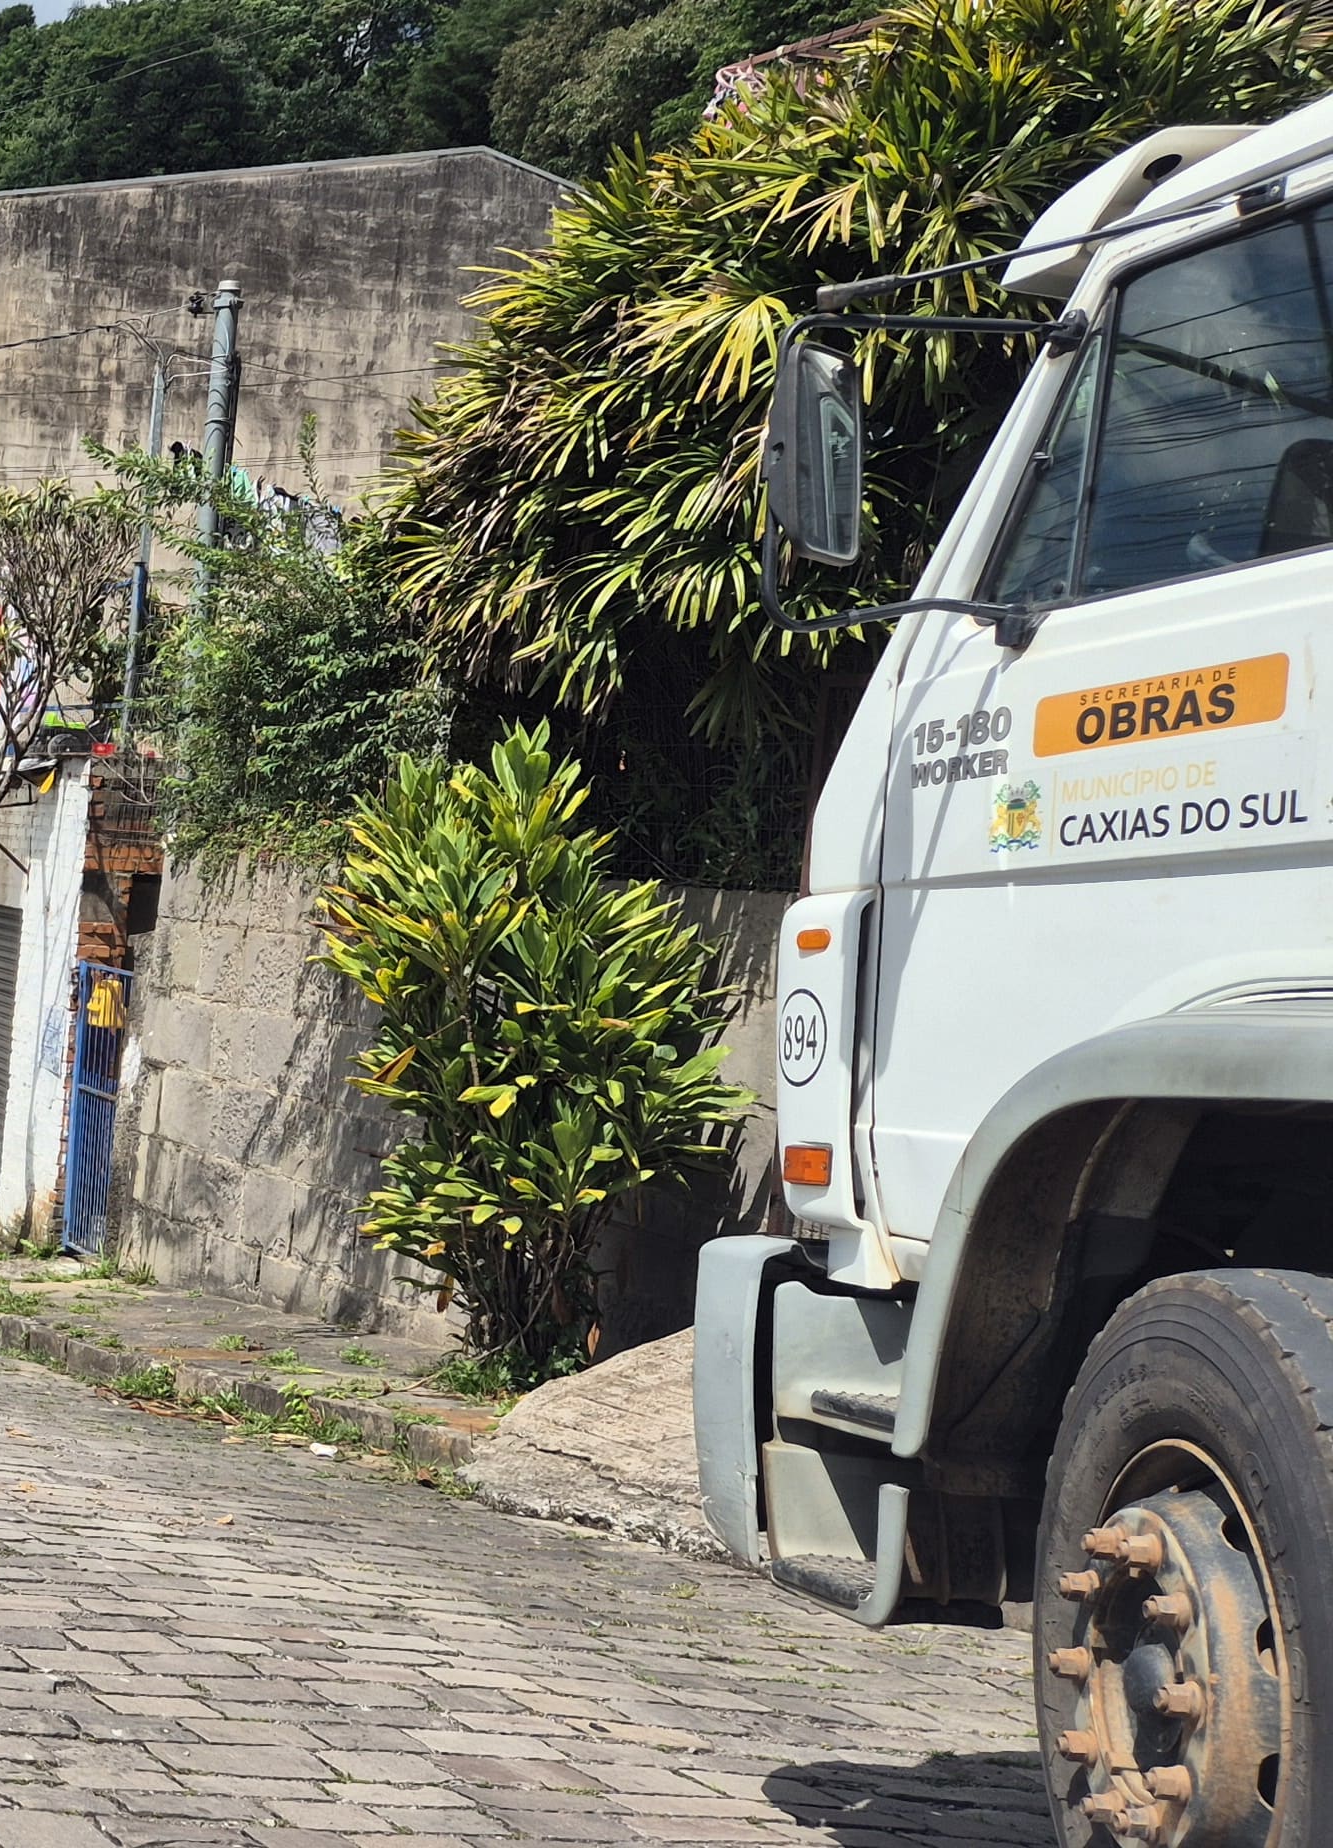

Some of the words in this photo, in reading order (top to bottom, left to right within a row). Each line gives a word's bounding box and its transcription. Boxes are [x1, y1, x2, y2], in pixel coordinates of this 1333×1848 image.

[1080, 673, 1204, 706] SECRETARIA
[1212, 667, 1237, 683] DE
[914, 706, 1012, 755] 15-180
[1076, 683, 1236, 745] OBRAS
[911, 749, 1009, 789] WORKER
[1061, 764, 1179, 804] MUNICÍPIO
[1186, 761, 1216, 788] DE
[1059, 804, 1171, 846] CAXIAS
[1180, 798, 1231, 835] DO
[1239, 789, 1308, 829] SUL
[784, 1014, 818, 1061] 894
